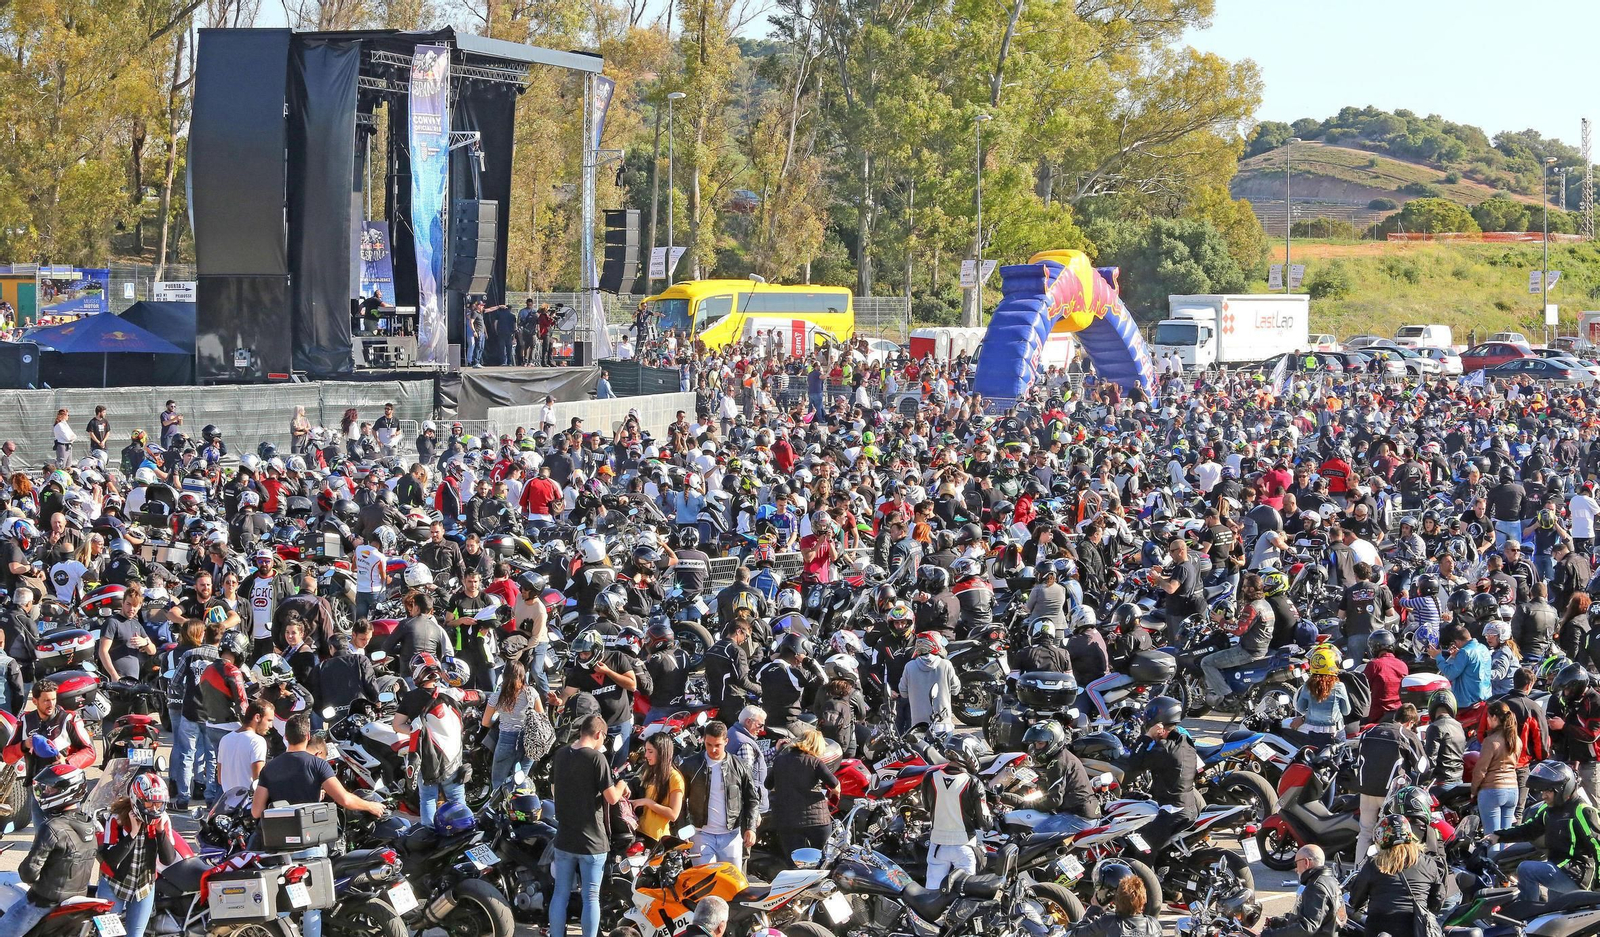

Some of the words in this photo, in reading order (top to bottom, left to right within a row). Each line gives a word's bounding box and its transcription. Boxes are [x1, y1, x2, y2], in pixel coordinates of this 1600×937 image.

[1255, 310, 1294, 330] LastLap
[1192, 648, 1208, 656] YAMAHA
[133, 751, 153, 759] 6114
[471, 845, 490, 857] 5293
[763, 896, 788, 909] REPSOL
[658, 917, 690, 936] REOL
